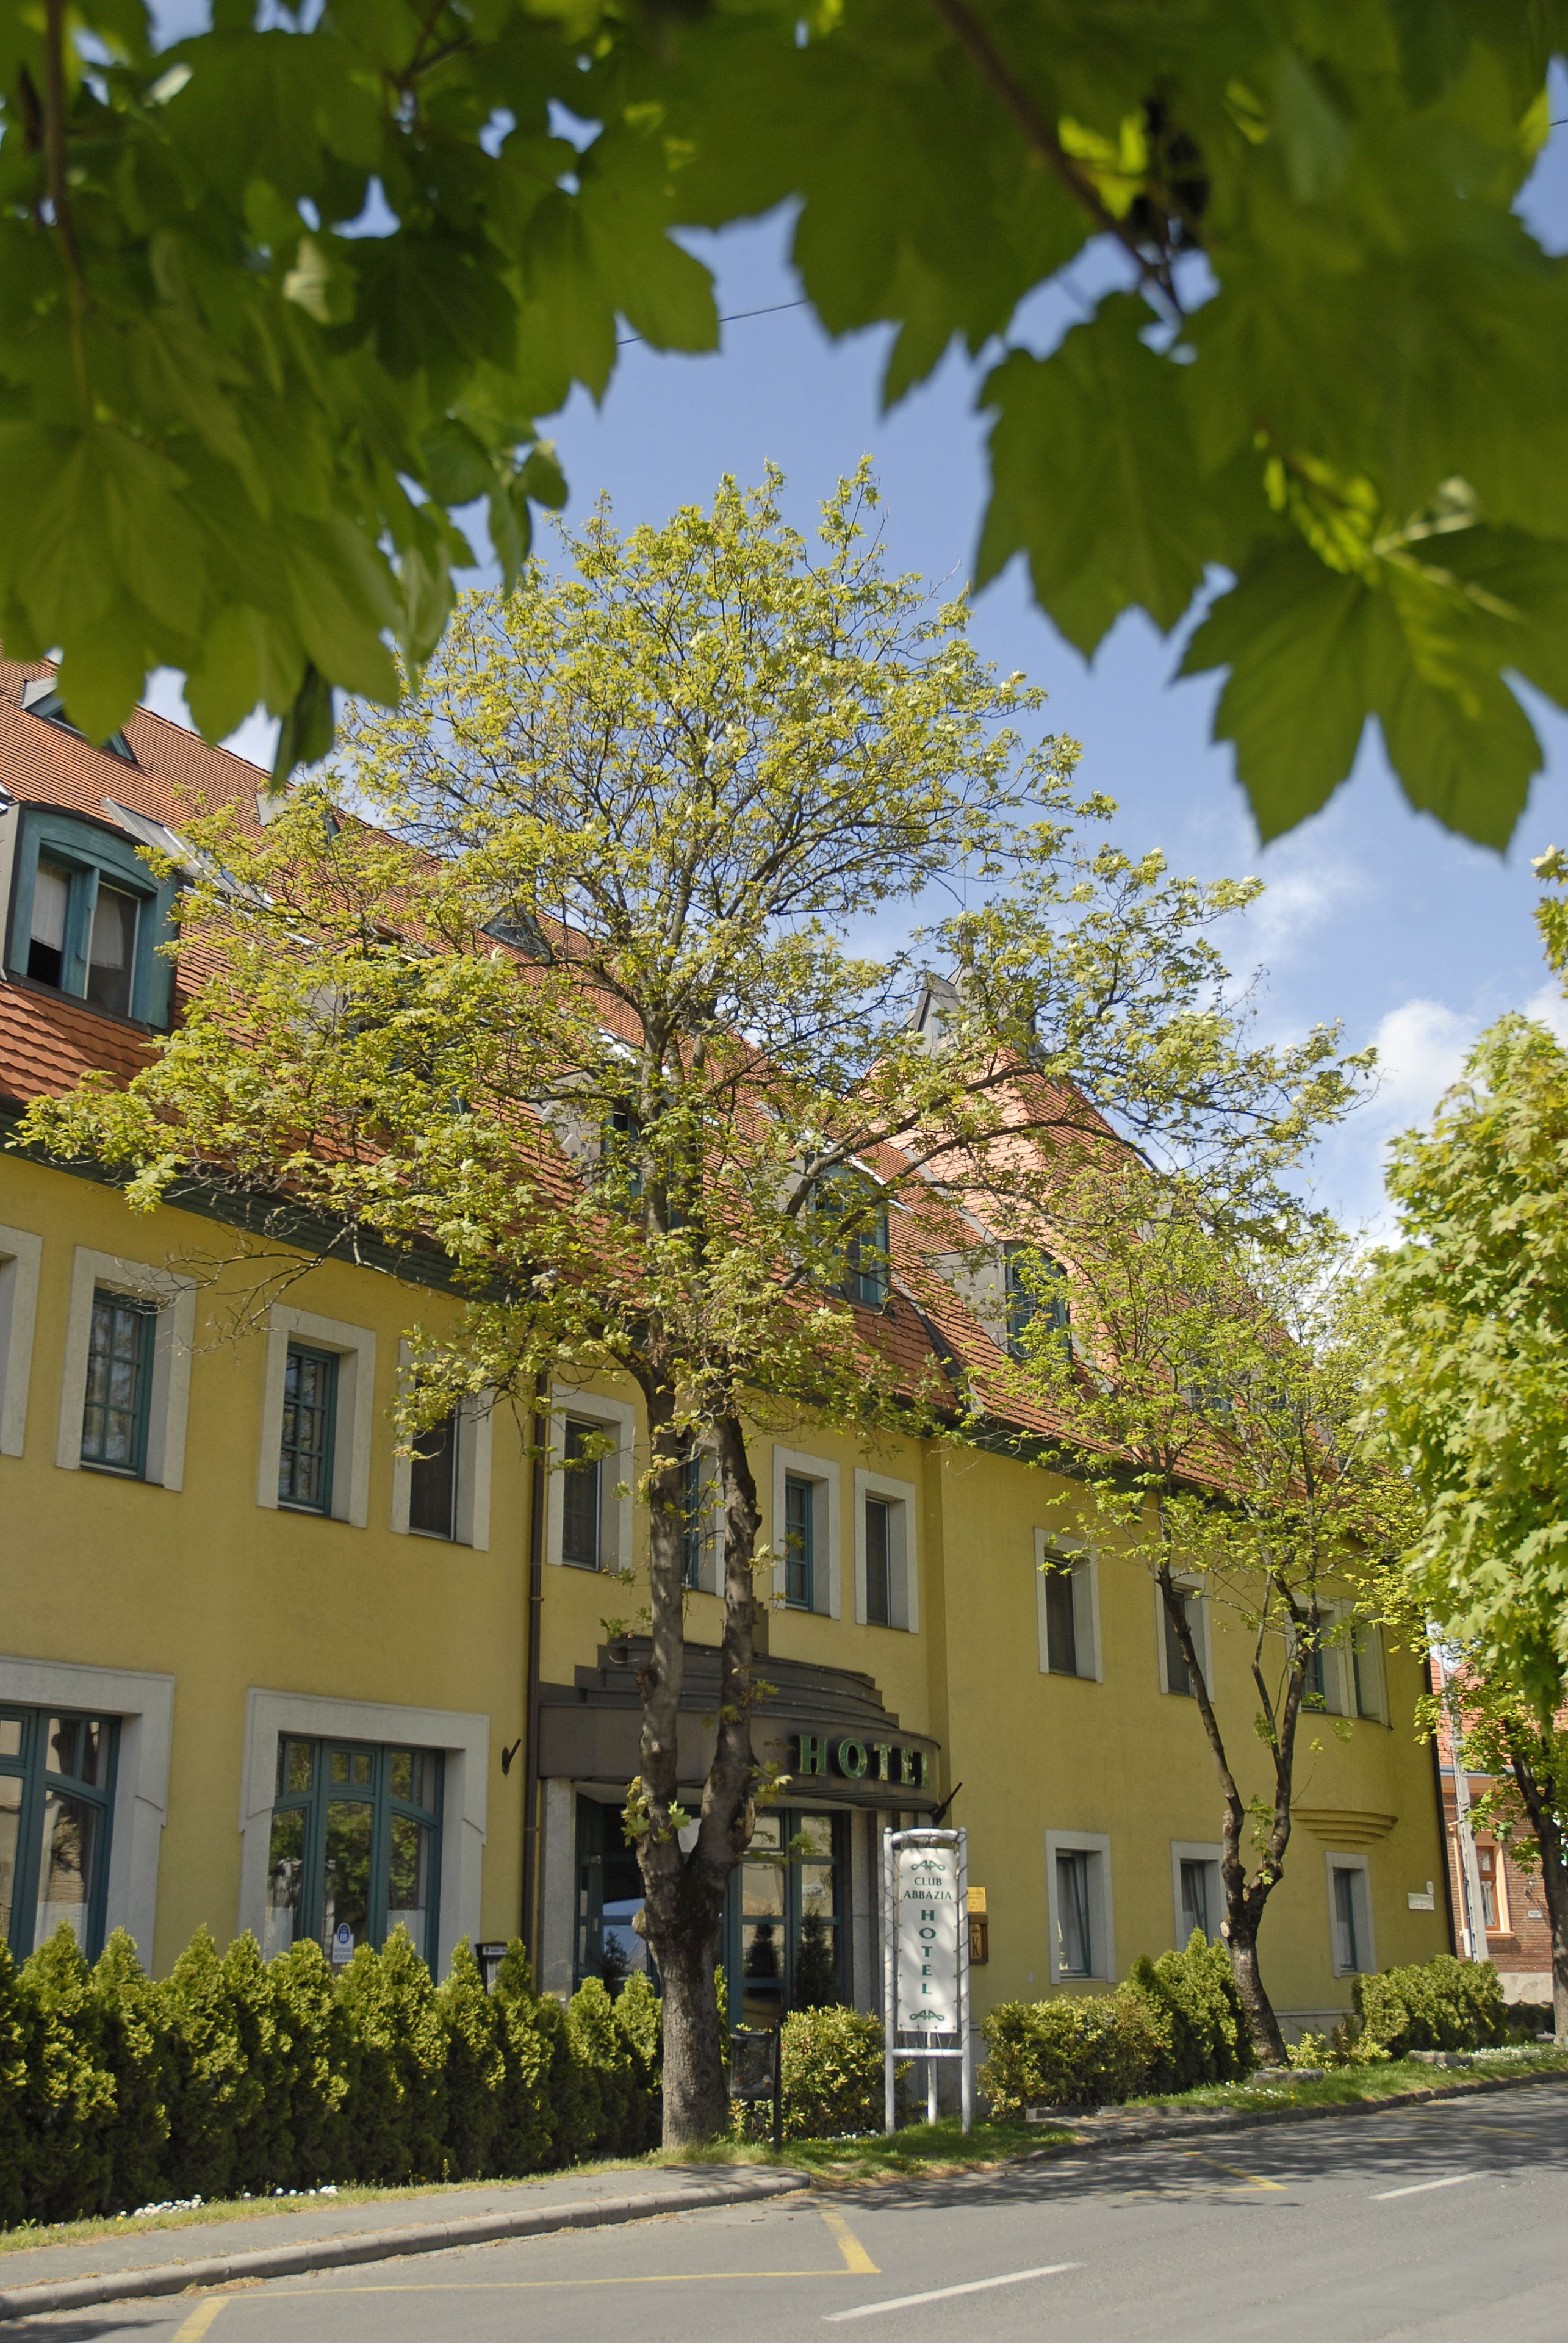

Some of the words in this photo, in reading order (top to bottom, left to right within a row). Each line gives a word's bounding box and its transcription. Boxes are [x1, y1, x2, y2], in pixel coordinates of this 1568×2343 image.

[799, 1735, 932, 1789] HOTEL
[914, 1876, 943, 1887] CLUB
[918, 1909, 937, 1995] HOTEL
